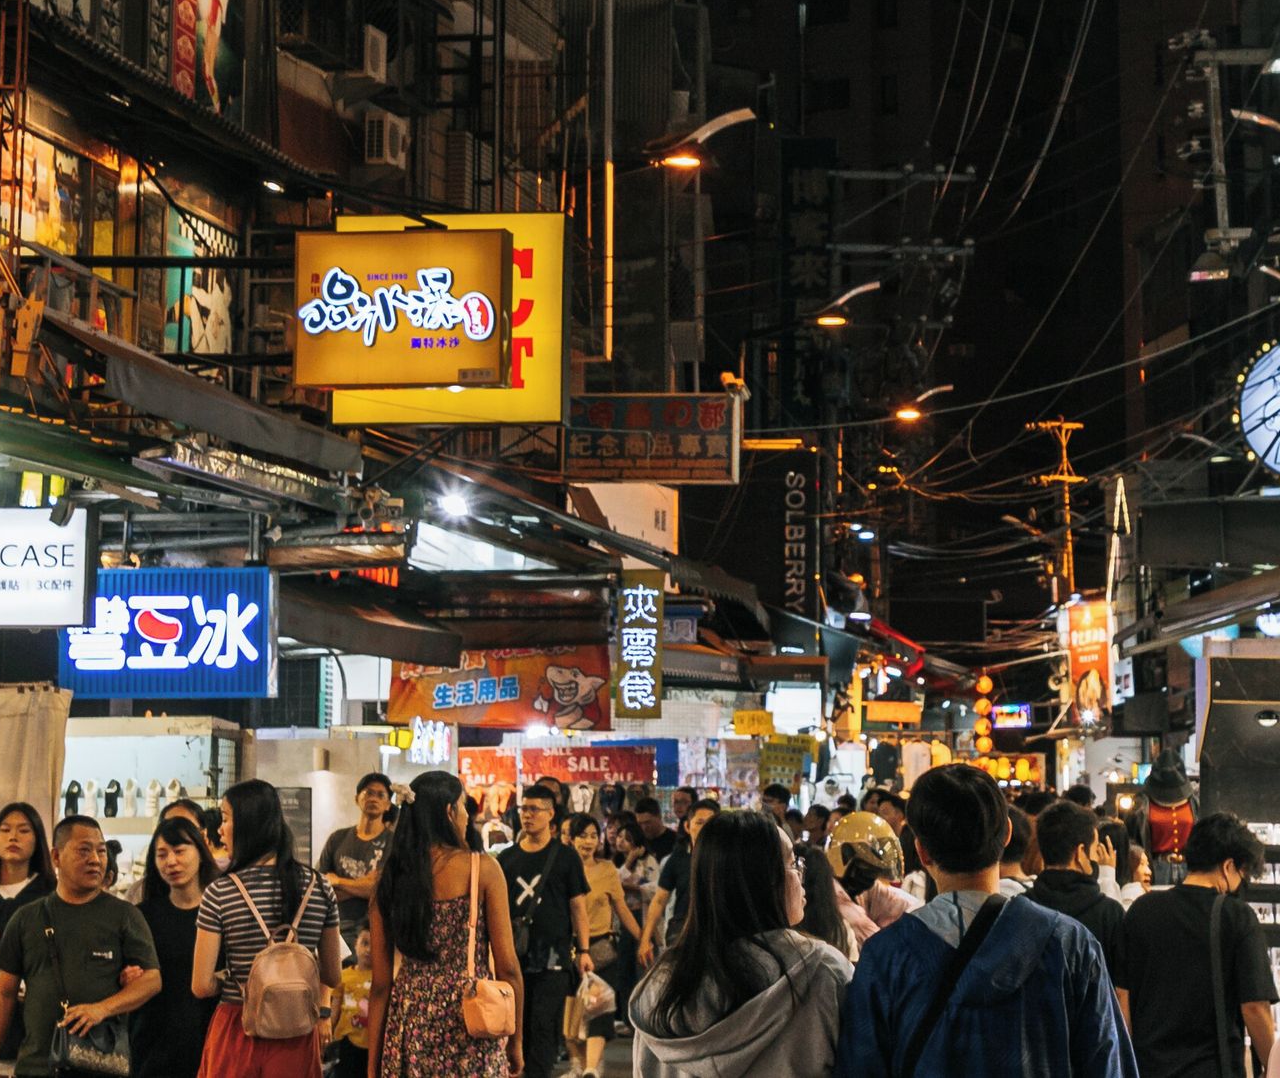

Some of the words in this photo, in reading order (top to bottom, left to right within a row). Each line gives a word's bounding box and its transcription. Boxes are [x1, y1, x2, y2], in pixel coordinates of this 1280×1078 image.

[367, 273, 389, 281] SINCE
[410, 337, 461, 350] 獨特冰沙
[783, 470, 806, 613] SOLBERRY
[621, 583, 660, 710] 夾零食
[432, 676, 521, 710] 生活用品
[567, 756, 610, 773] SALE
